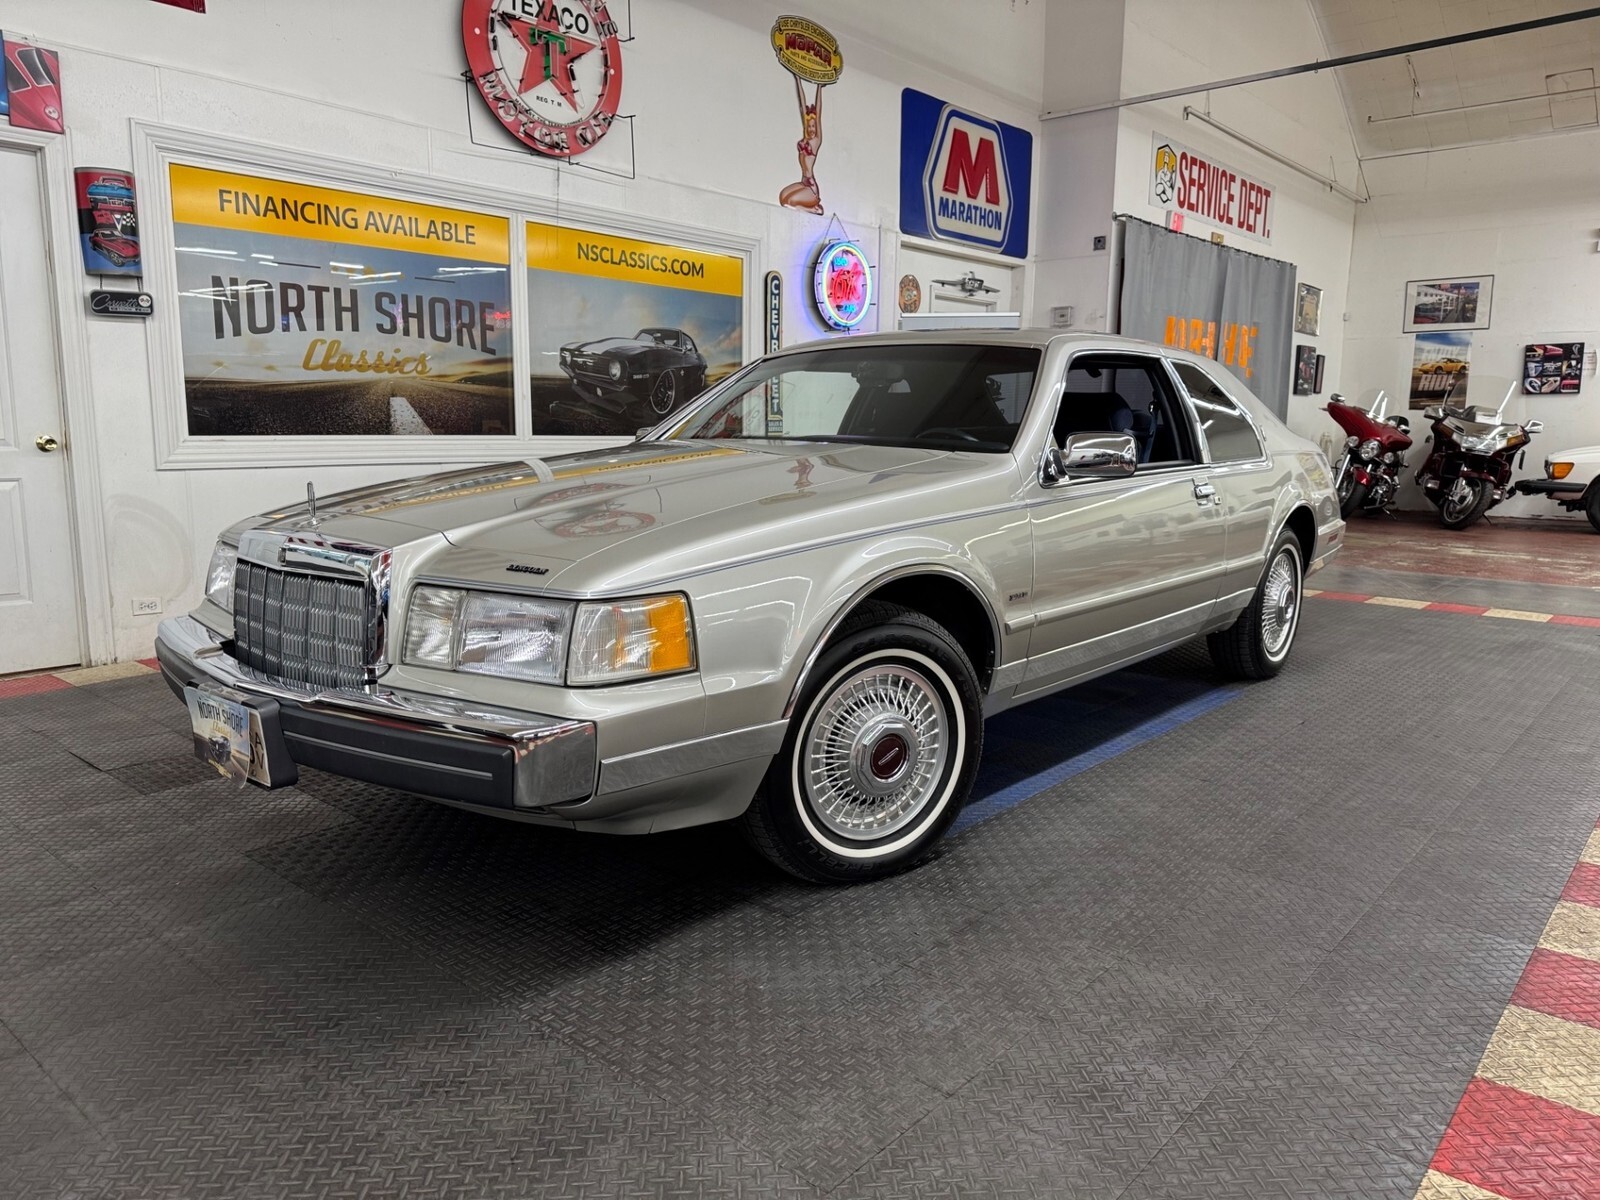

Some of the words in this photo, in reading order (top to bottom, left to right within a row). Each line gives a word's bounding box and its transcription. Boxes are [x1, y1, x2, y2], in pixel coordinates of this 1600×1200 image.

[512, 0, 589, 34] TEXACO
[785, 32, 832, 68] MOPAR
[942, 128, 1000, 206] M
[938, 196, 1002, 231] MARATHON
[1177, 151, 1237, 226] SERVICE
[1237, 178, 1271, 239] DEPT.
[218, 189, 359, 230] FINANCING
[364, 210, 477, 246] AVAILABLE
[577, 242, 704, 279] NSCLASSICS.COM
[211, 274, 360, 340] NORTH
[374, 291, 497, 357] SHORE
[302, 338, 433, 376] Classics
[771, 279, 781, 412] CHEVRLET
[197, 699, 222, 722] NORTH
[221, 708, 243, 738] SHORE
